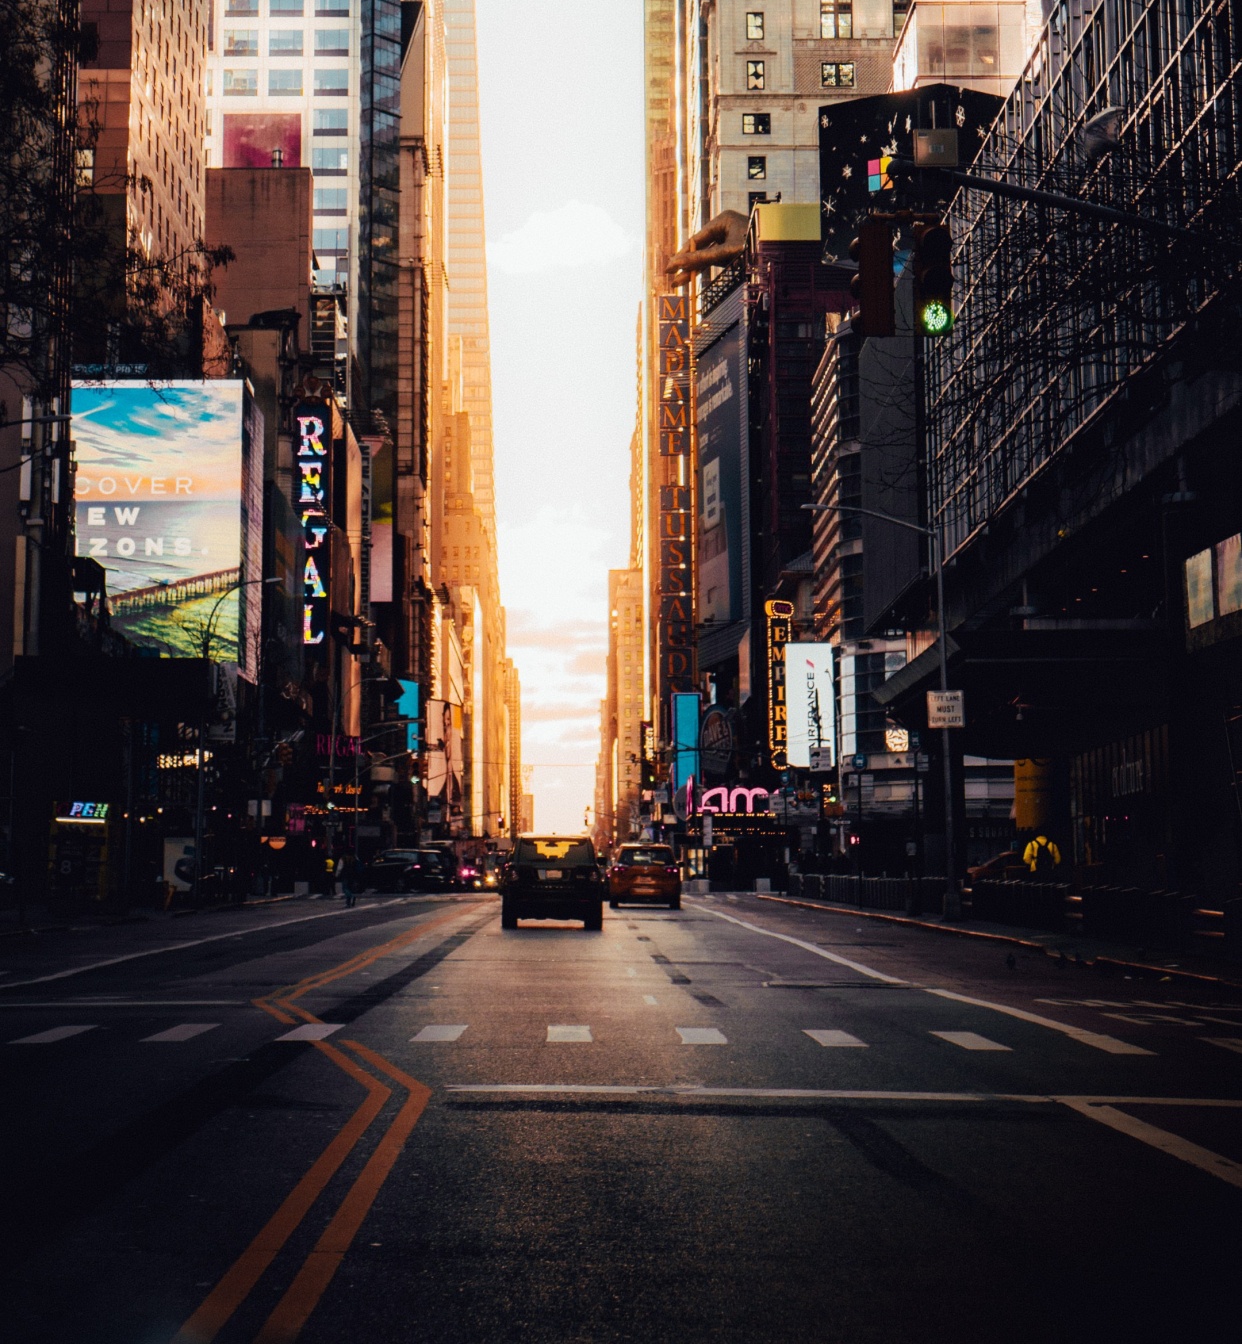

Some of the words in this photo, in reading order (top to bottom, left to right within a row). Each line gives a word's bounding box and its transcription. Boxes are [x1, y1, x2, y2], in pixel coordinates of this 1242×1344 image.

[661, 297, 687, 454] MADAME
[75, 477, 193, 495] COVER
[88, 507, 140, 526] EW
[296, 416, 328, 644] REGAL
[772, 626, 787, 742] EMPIRE
[316, 733, 364, 757] REGAL
[696, 786, 780, 813] am
